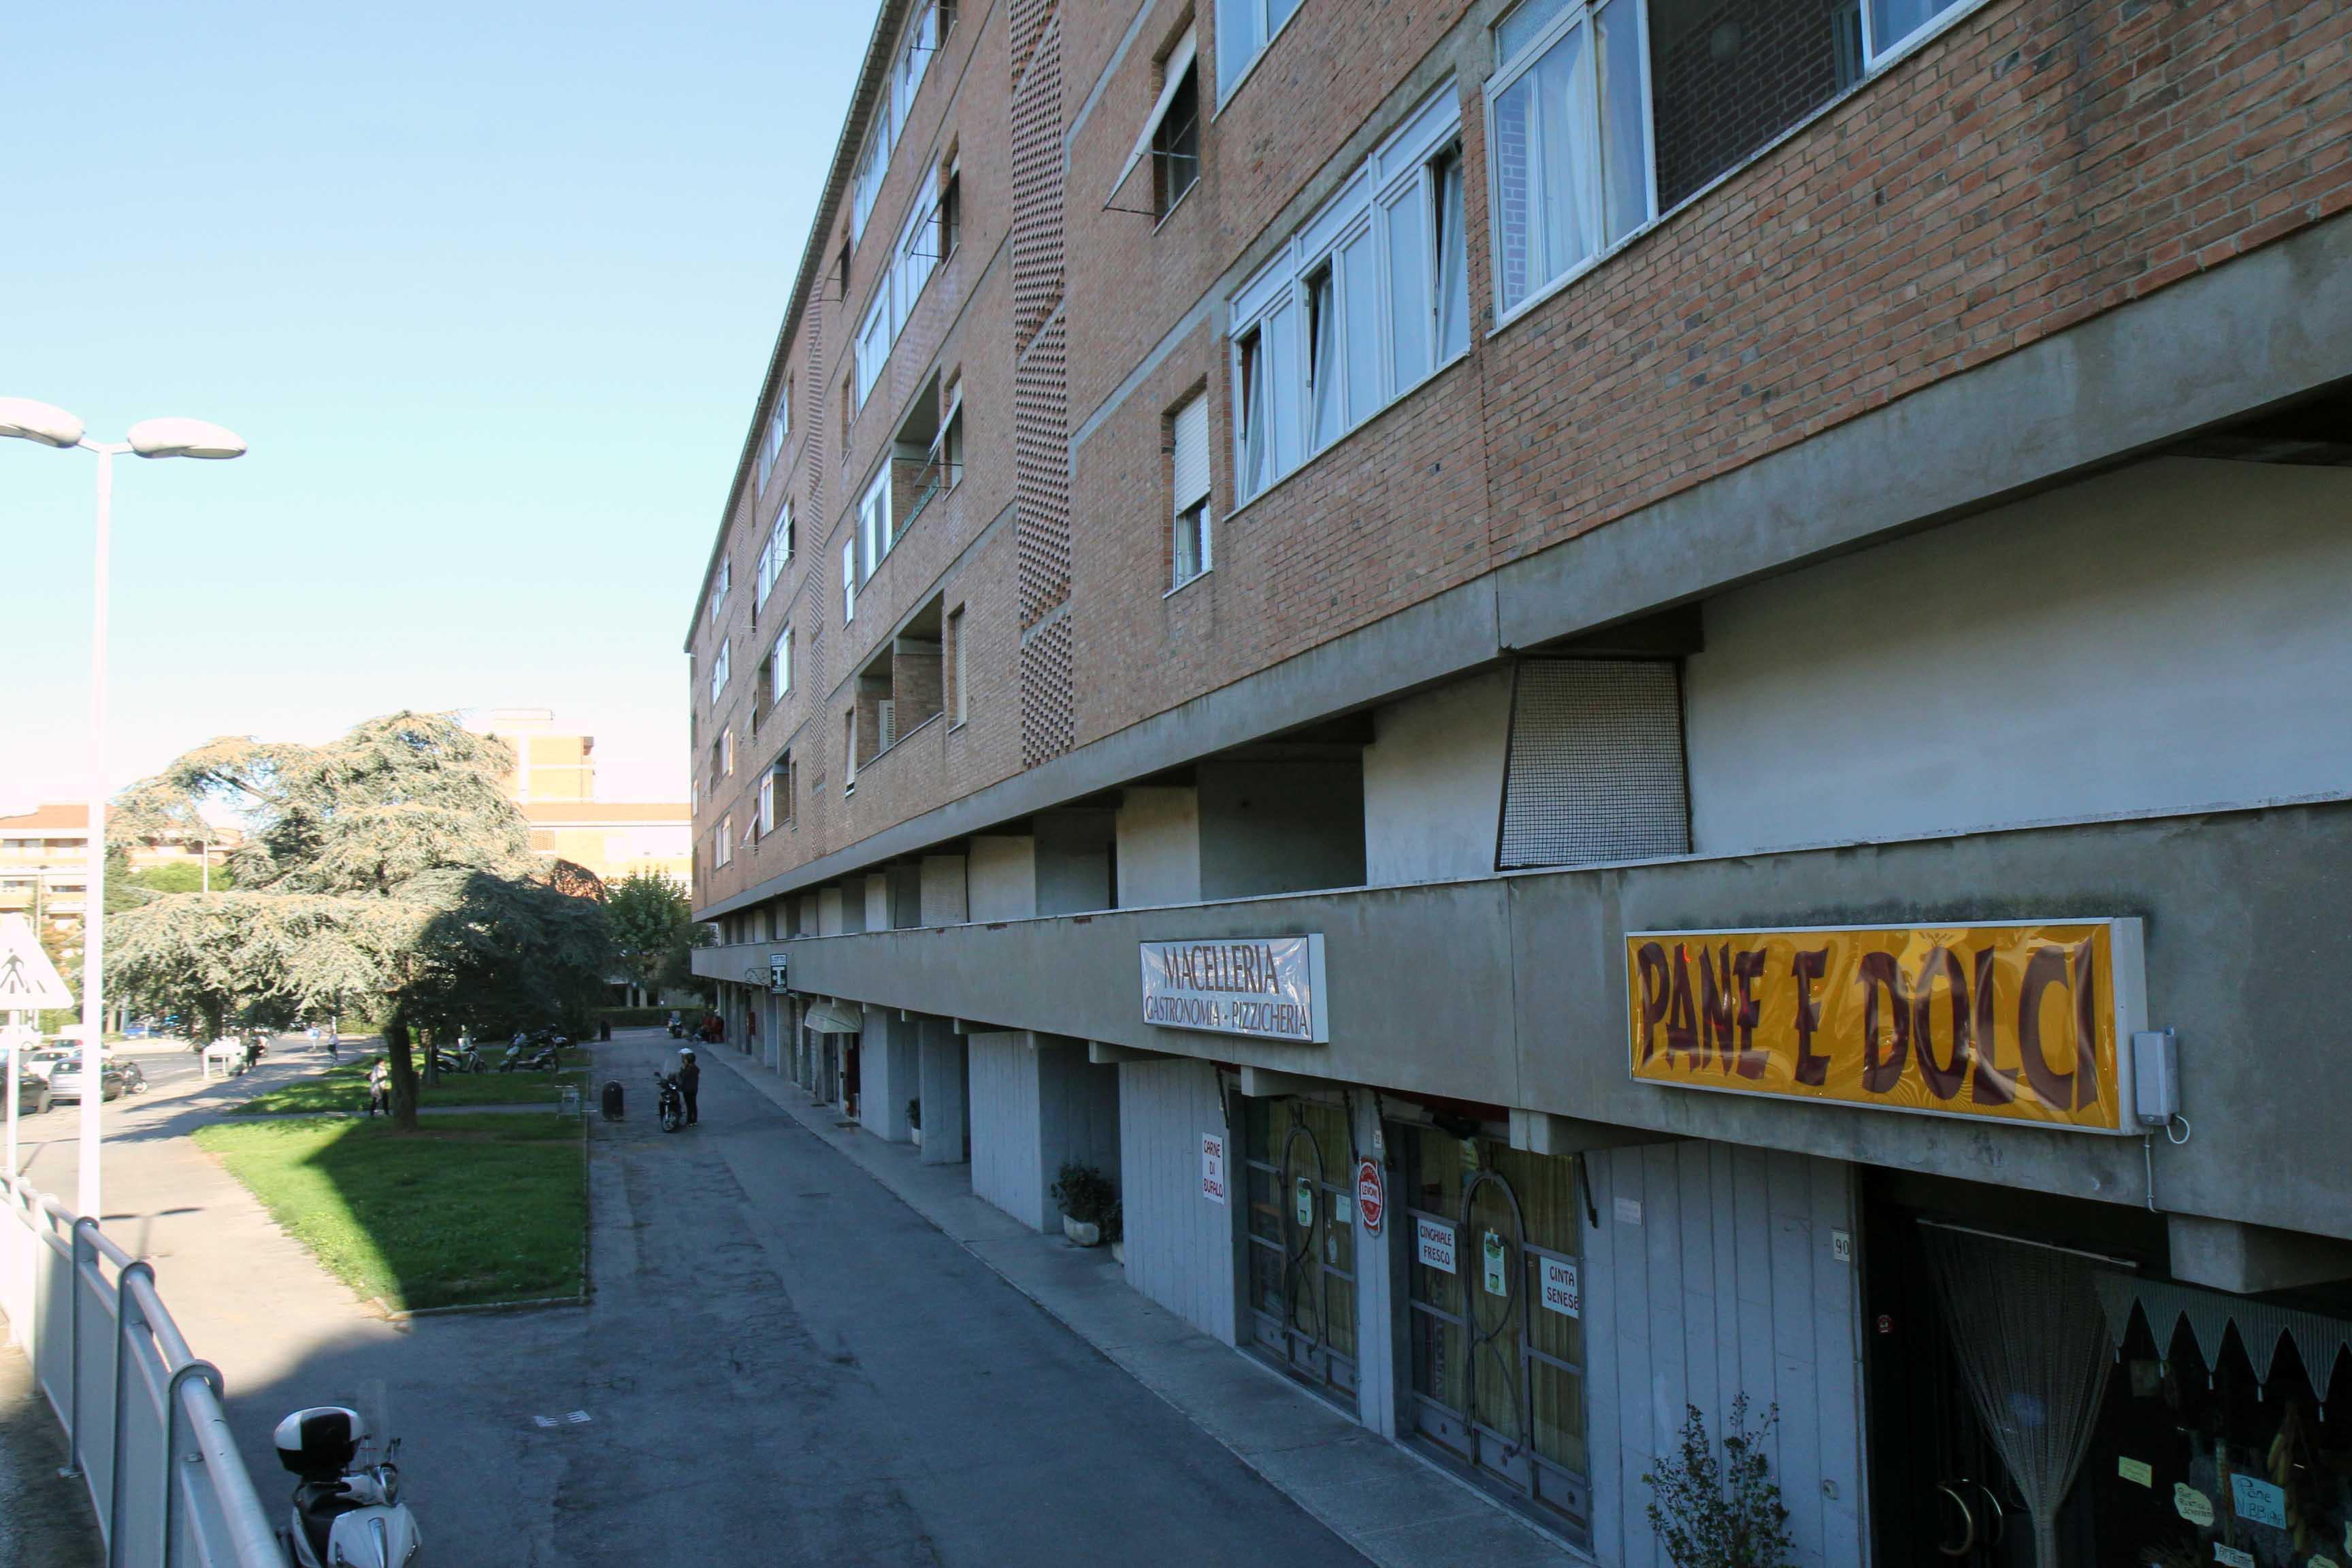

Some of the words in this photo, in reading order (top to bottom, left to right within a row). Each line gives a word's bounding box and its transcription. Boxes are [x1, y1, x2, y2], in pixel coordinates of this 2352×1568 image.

[1162, 943, 1280, 994] MACELLERIA
[1146, 996, 1220, 1026] GASTRONOMIA
[1232, 1001, 1308, 1035] PIZZICHERIA
[1637, 941, 1770, 1081] PANE
[1791, 946, 1831, 1086] E
[1855, 936, 2097, 1113] DOLCI
[1203, 1139, 1220, 1158] CARNE
[1209, 1160, 1215, 1176] DI
[1203, 1178, 1223, 1198] BUFALO
[1420, 1224, 1452, 1247] CINGHIALE
[1423, 1245, 1450, 1265] FRESCO
[1835, 1239, 1849, 1255] 90
[1550, 1266, 1574, 1287] CINTA
[1547, 1286, 1579, 1311] SENESE
